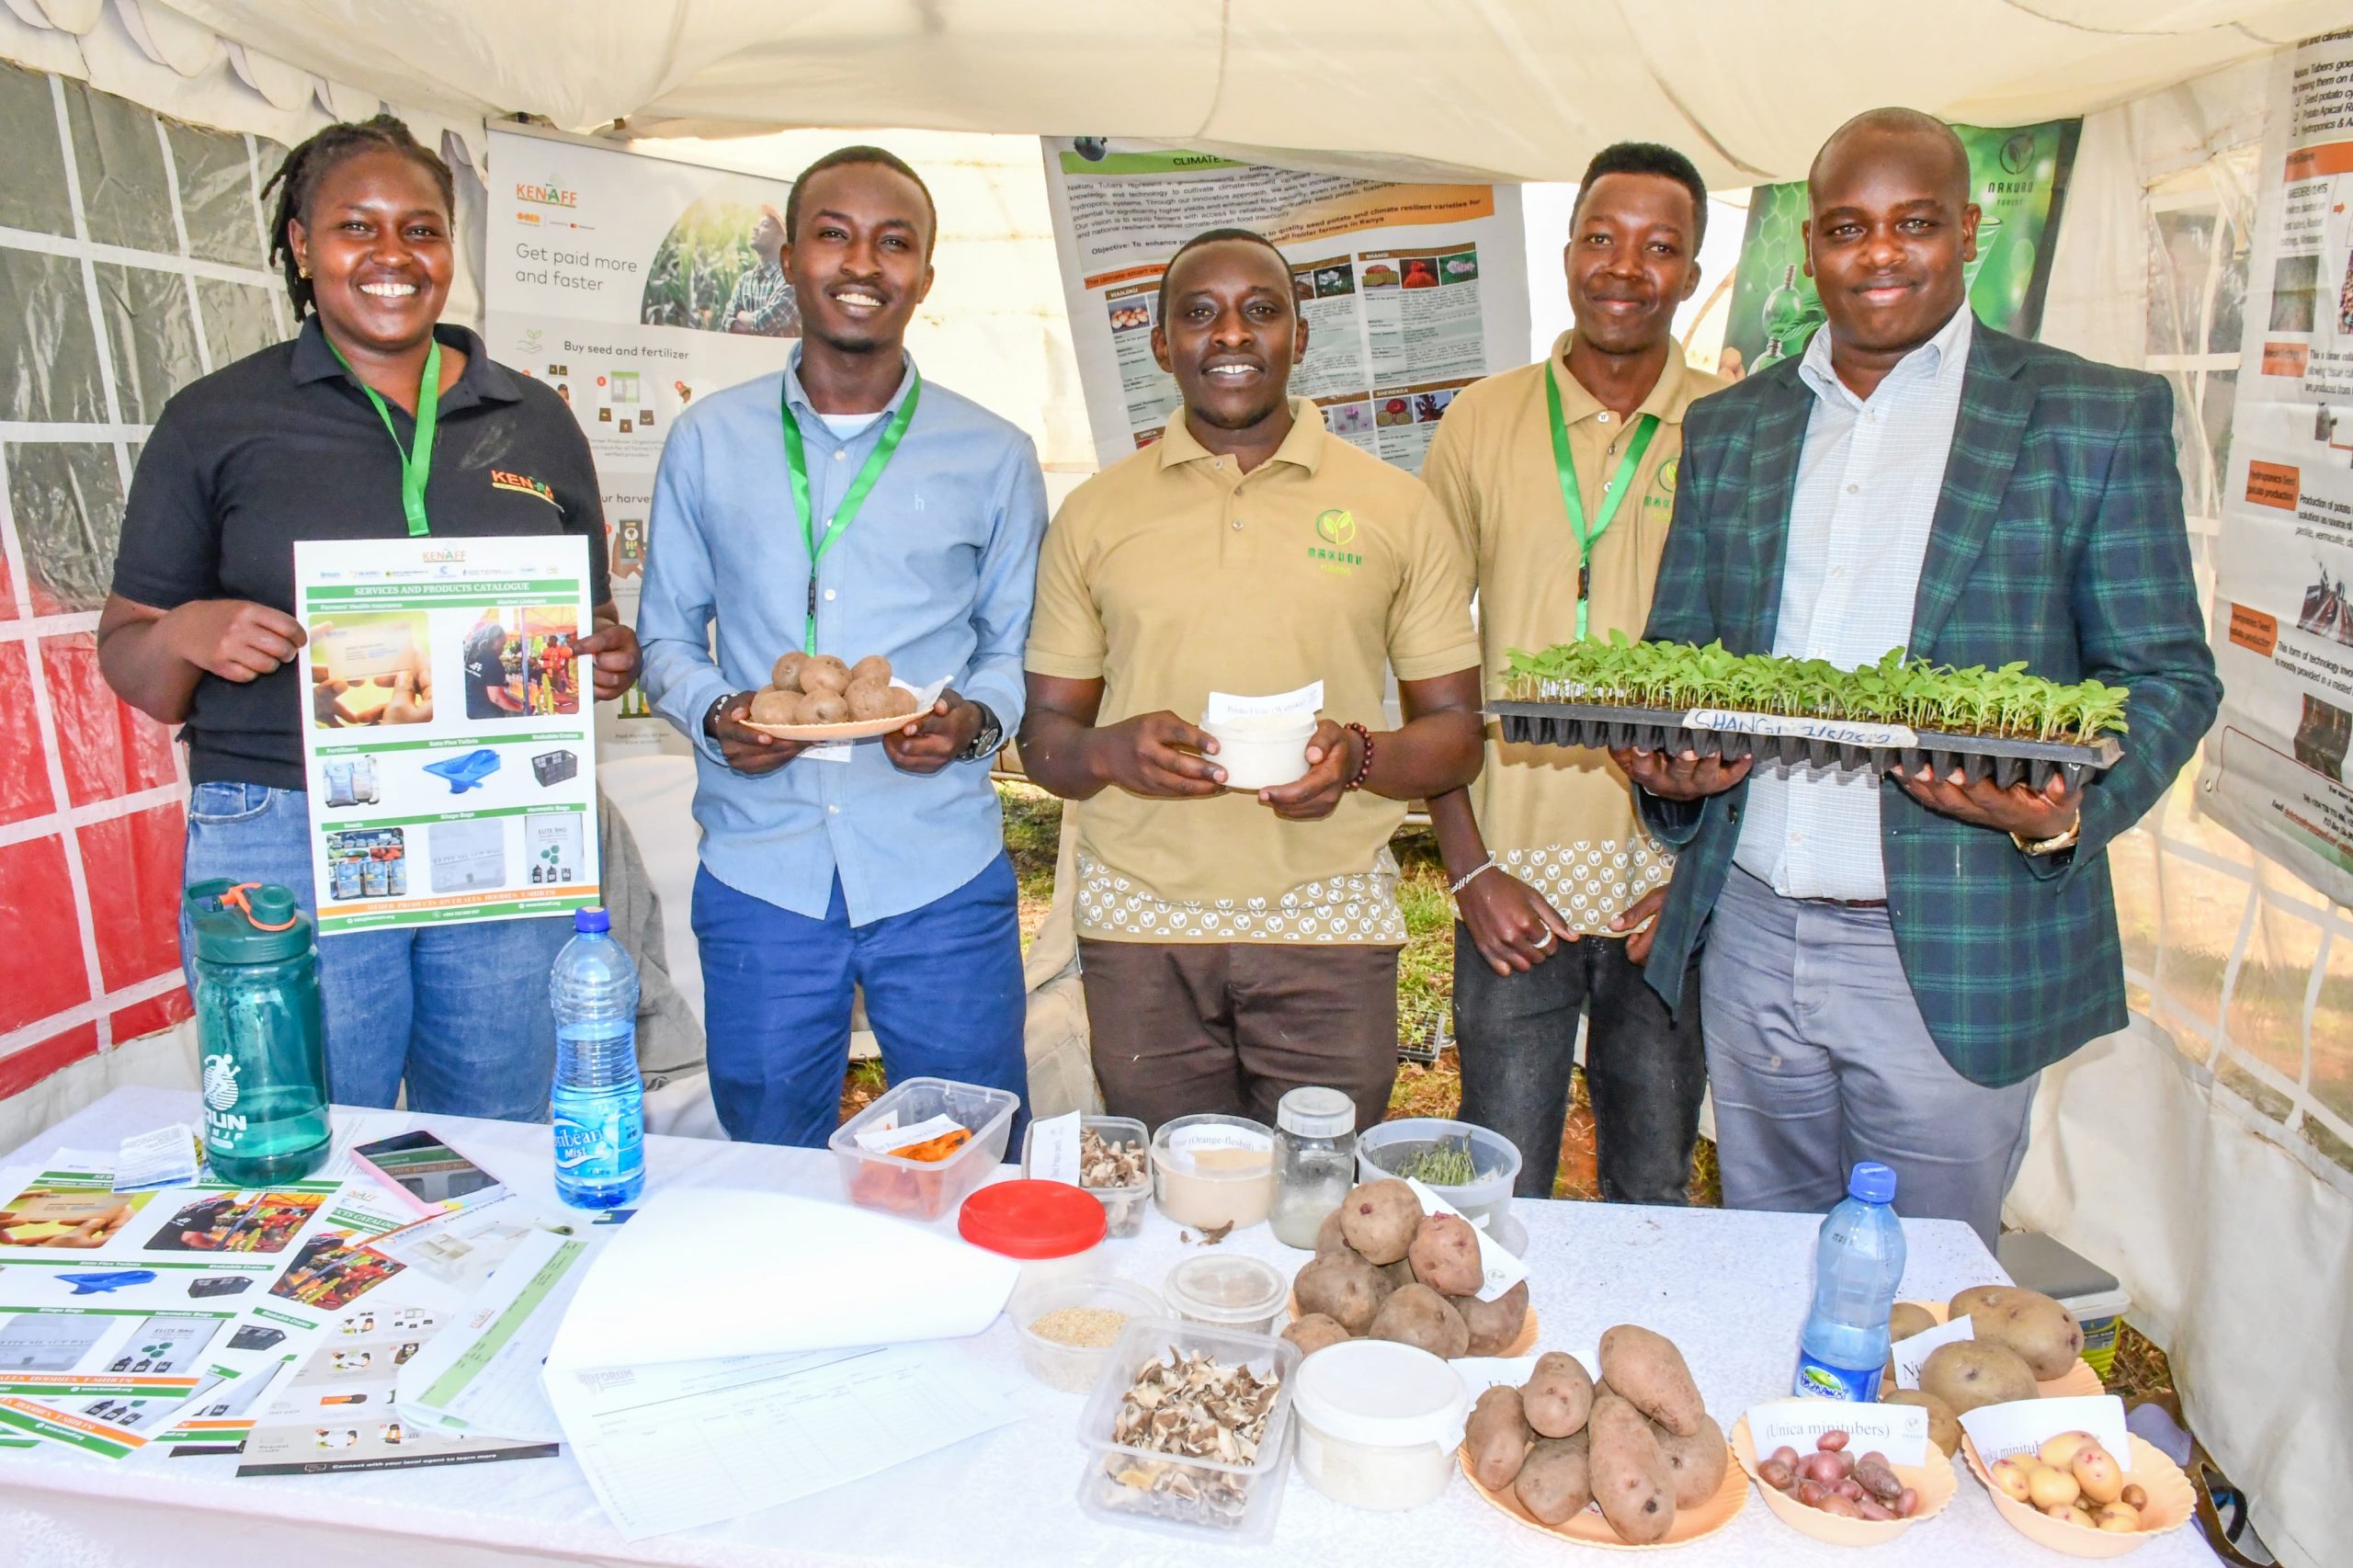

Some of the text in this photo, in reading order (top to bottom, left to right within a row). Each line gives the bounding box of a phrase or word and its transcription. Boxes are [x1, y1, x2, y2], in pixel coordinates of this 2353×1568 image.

[2311, 62, 2334, 74] Tubers
[2316, 75, 2347, 87] them on
[2304, 91, 2343, 105] Seed potato
[2320, 103, 2344, 117] Apical
[2337, 117, 2345, 128] &
[1173, 155, 1221, 166] CLIMATE
[1987, 181, 2034, 194] NAKURU
[517, 183, 578, 206] KENAFF
[1129, 190, 1168, 199] technology
[1192, 194, 1230, 202] innovative
[1073, 211, 1104, 222] potential
[1117, 208, 1157, 216] significantly
[1184, 205, 1205, 213] yields
[1222, 199, 1258, 208] enhanced
[1260, 196, 1277, 204] food
[1311, 187, 1329, 196] even
[1091, 219, 1112, 227] vision
[1132, 215, 1153, 223] equip
[1154, 213, 1181, 222] farmers
[1184, 211, 1199, 220] with
[1270, 199, 1313, 212] high-quality
[1314, 193, 1334, 201] seed
[1278, 223, 1304, 234] quality
[1306, 220, 1325, 229] seed
[1326, 216, 1351, 225] potato
[1354, 211, 1369, 220] and
[1370, 207, 1399, 217] climate
[1400, 203, 1432, 212] resilient
[1434, 201, 1468, 210] varieties
[1076, 231, 1091, 239] and
[1092, 226, 1120, 236] national
[1121, 223, 1155, 232] resilience
[1157, 222, 1183, 230] against
[1184, 218, 1235, 228] climate-driven
[1270, 234, 1290, 243] small
[1291, 230, 1317, 238] holder
[1318, 223, 1348, 233] farmers
[1359, 217, 1384, 226] Kenya
[1144, 238, 1176, 246] enhance
[516, 243, 638, 273] Get paid more
[516, 269, 604, 291] and faster
[1110, 287, 1139, 299] WANJIKU
[564, 340, 689, 360] Buy seed and fertilizer
[1376, 388, 1409, 397] SHEREKEA
[1140, 429, 1158, 438] UNICA
[2300, 494, 2351, 515] Production of potato
[2299, 511, 2347, 529] solution as source
[423, 550, 467, 562] KENAFF
[354, 582, 530, 596] SERVICES AND PRODUCTS CATALOGUE
[519, 597, 547, 605] Linkages
[2278, 640, 2339, 675] This form of technology
[2275, 658, 2279, 666] is
[2279, 660, 2297, 675] mostly
[2297, 666, 2321, 682] provided
[2321, 676, 2326, 685] in
[555, 804, 571, 812] Bags
[459, 811, 475, 819] Bags
[564, 1146, 587, 1159] Mist
[39, 1307, 64, 1315] Silage
[154, 1310, 192, 1318] Hermetic
[290, 1316, 311, 1328] Crates
[1766, 1423, 1804, 1439] (Unica
[332, 1462, 366, 1471] Connect
[422, 1457, 446, 1465] agent
